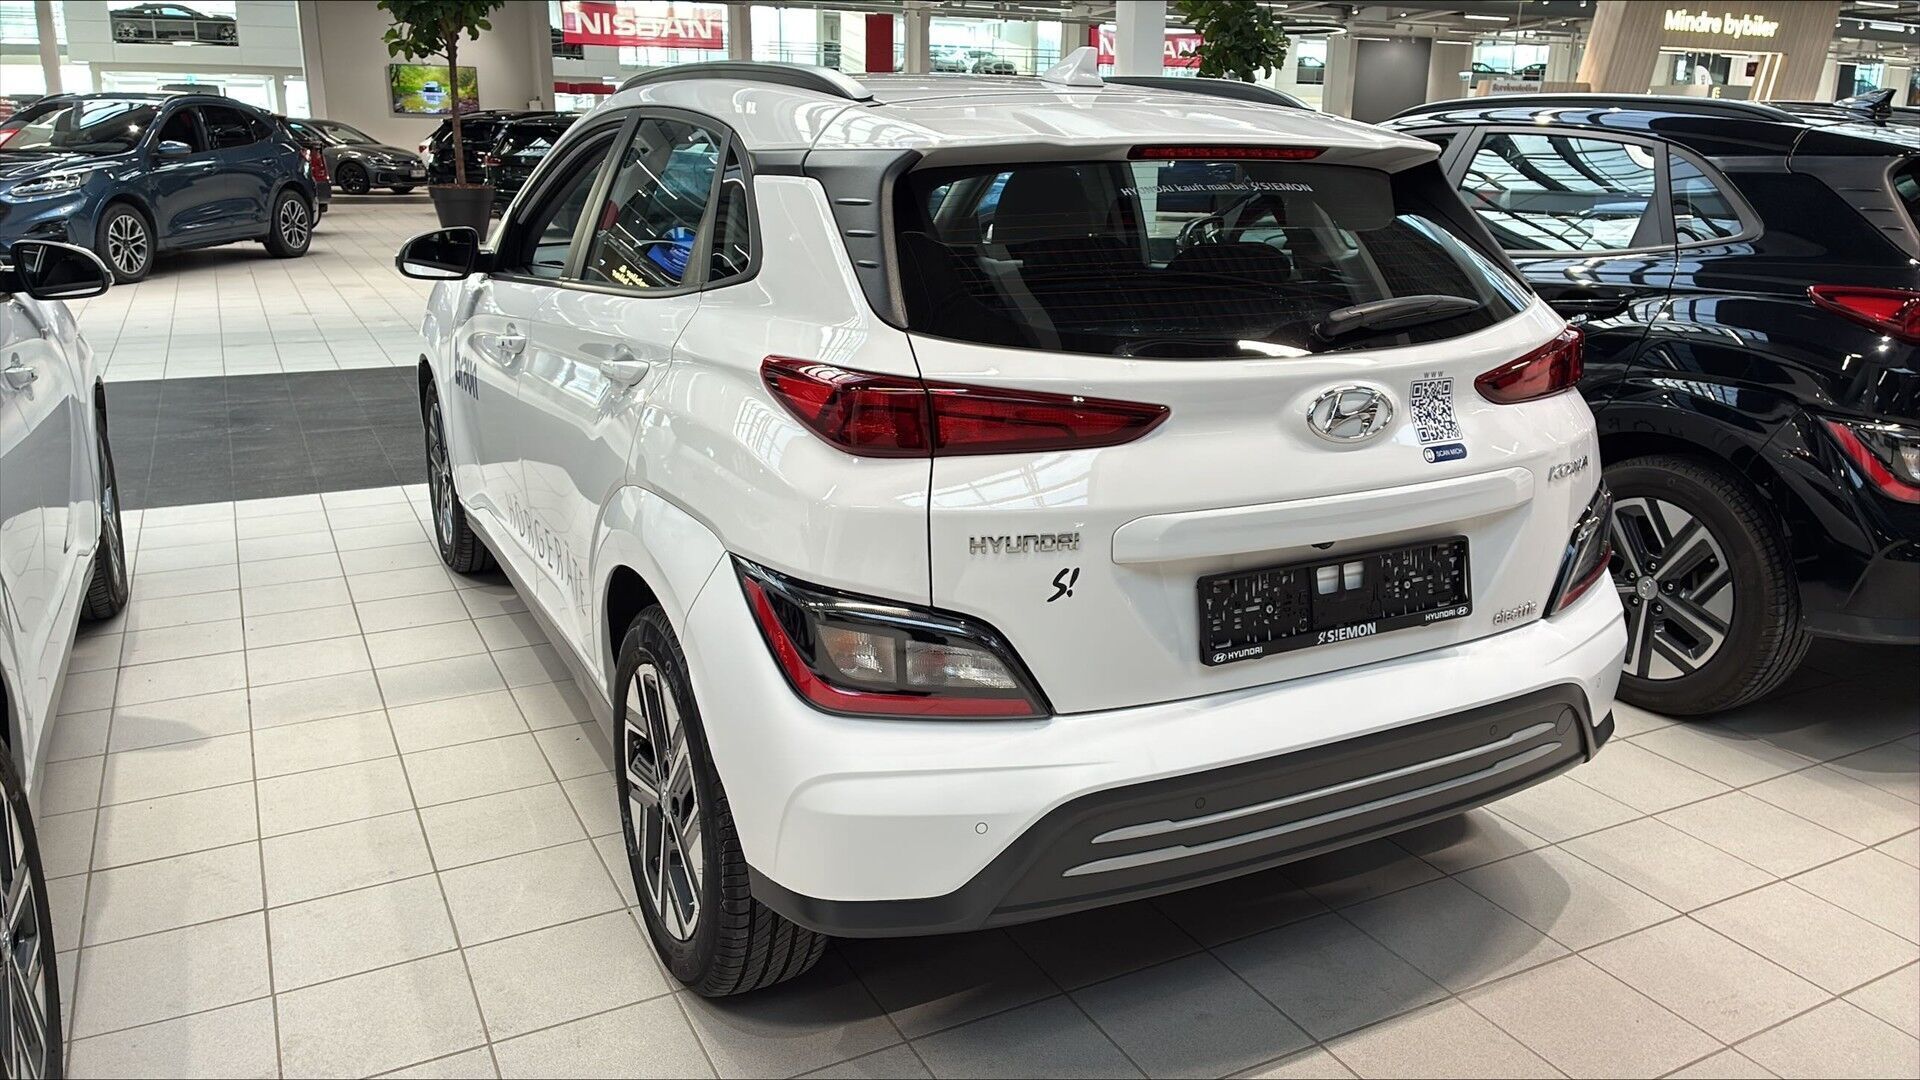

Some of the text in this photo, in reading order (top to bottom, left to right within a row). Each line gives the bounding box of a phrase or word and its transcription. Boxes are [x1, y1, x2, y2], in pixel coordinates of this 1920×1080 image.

[576, 11, 716, 39] NISSAN
[1664, 9, 1779, 39] Mindre bybiler
[1176, 183, 1204, 192] kauft
[505, 490, 586, 616] HÖRGERÄTE
[969, 532, 1080, 555] HYUNDAI
[1425, 608, 1456, 621] HYUNDAI
[1493, 600, 1537, 626] electric
[1228, 646, 1263, 660] HYUNDAI
